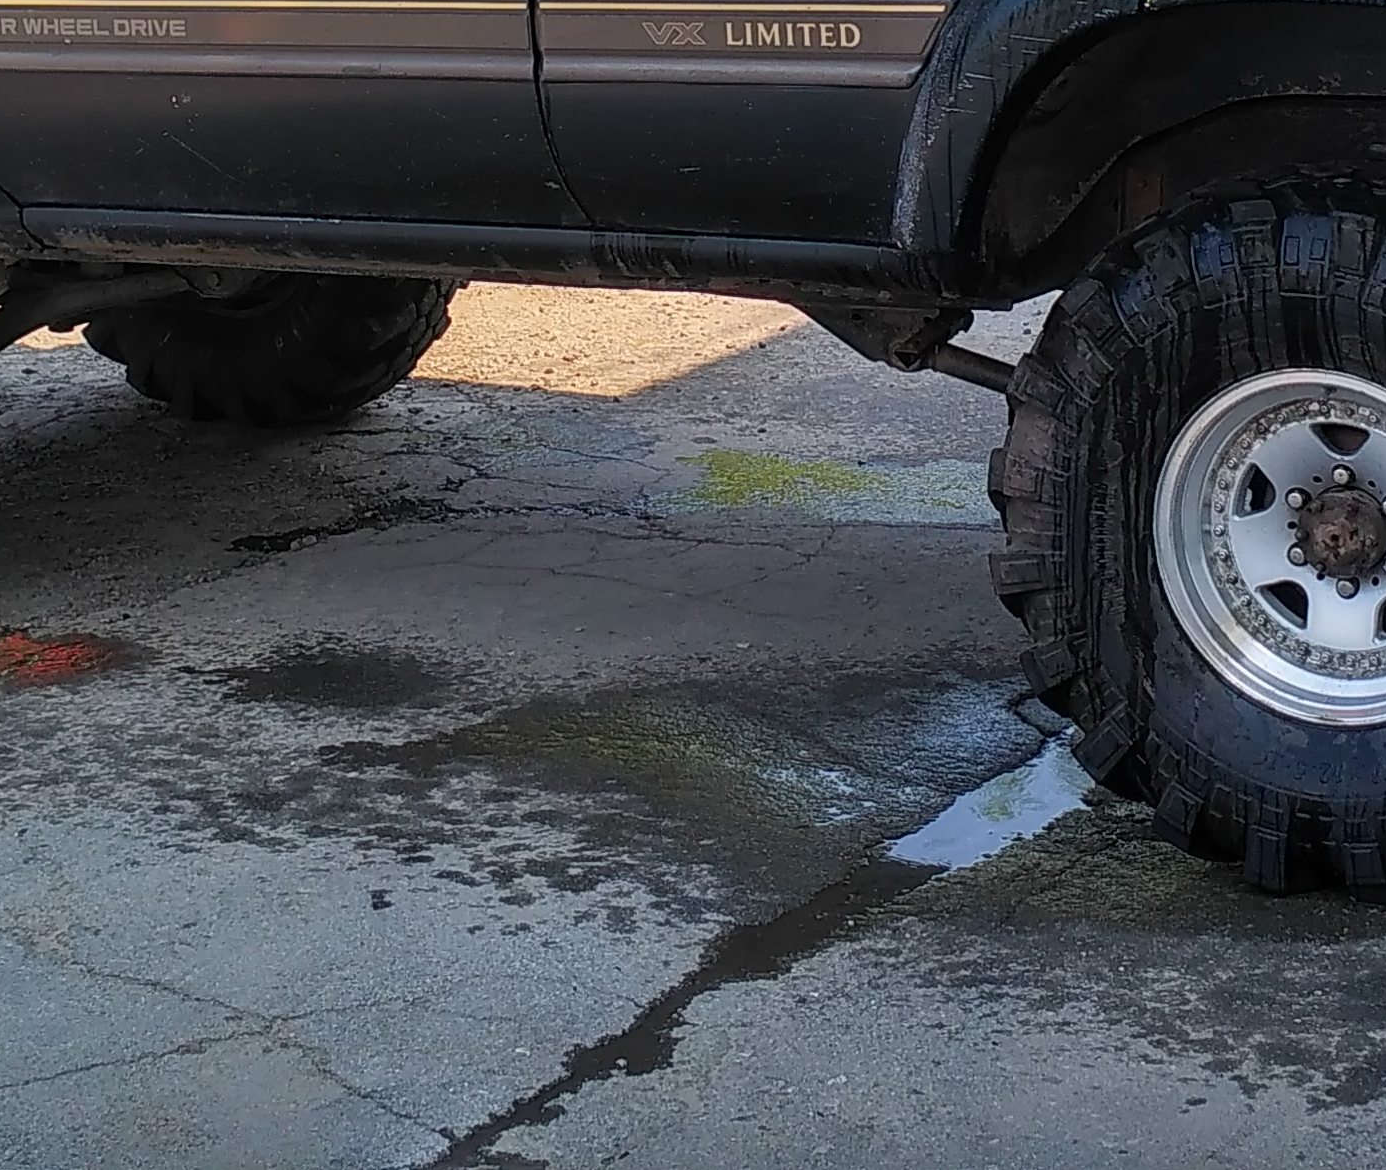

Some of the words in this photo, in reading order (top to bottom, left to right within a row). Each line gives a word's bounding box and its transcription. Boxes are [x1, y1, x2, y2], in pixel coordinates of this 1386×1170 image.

[23, 17, 110, 36] WHEEL
[113, 18, 187, 37] DRIVE
[642, 22, 707, 45] VX
[725, 22, 861, 48] LIMITED
